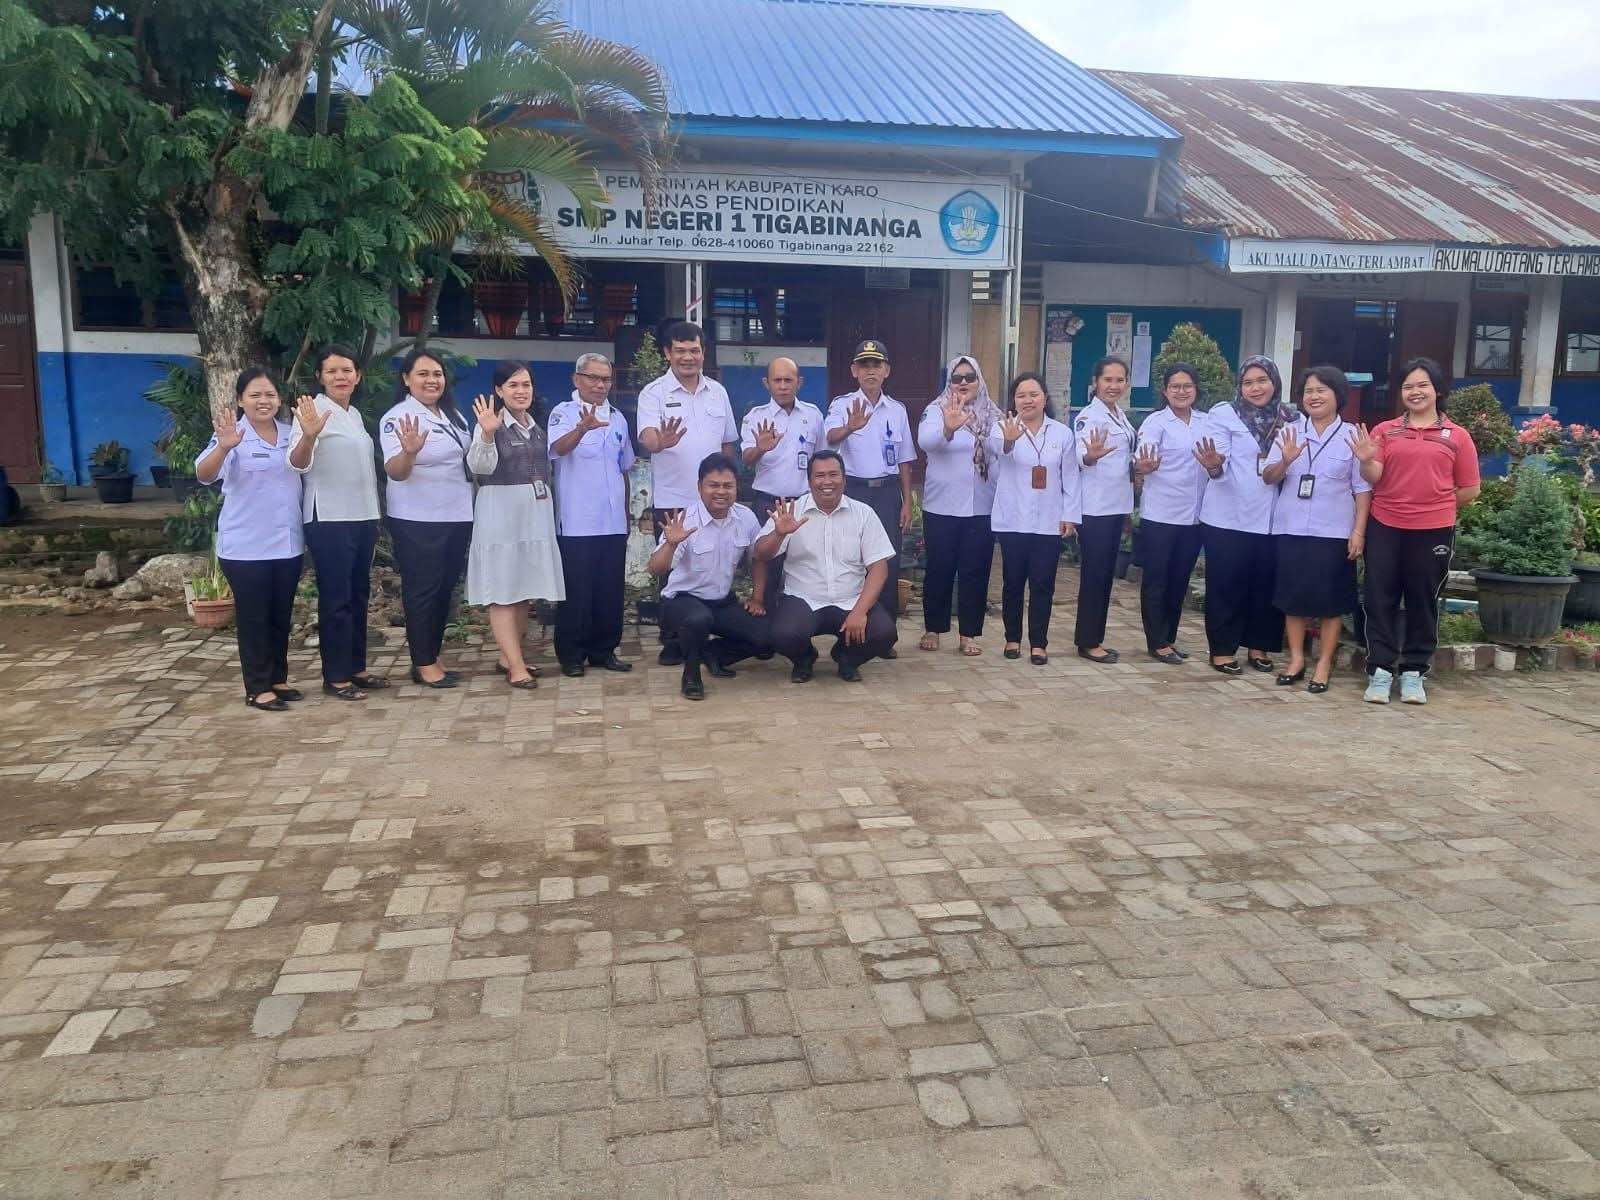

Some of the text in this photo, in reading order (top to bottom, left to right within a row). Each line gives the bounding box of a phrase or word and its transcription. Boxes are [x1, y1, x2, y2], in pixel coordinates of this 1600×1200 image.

[605, 175, 880, 198] PEMRINTAH KABUPATEN KARO
[716, 195, 844, 214] PENDIDIKAN
[625, 209, 722, 232] NEGERI
[731, 212, 747, 233] 1
[752, 213, 923, 239] TIGABINANGA
[589, 234, 895, 254] Jln. Juhar Telp. 0628-410060 Tigabinanga 22162
[1248, 252, 1425, 270] AKU MALU DATANG TERLAMBAT
[1434, 249, 1461, 271] AKU
[1461, 250, 1495, 272] MALU
[1494, 251, 1544, 273] DATANG
